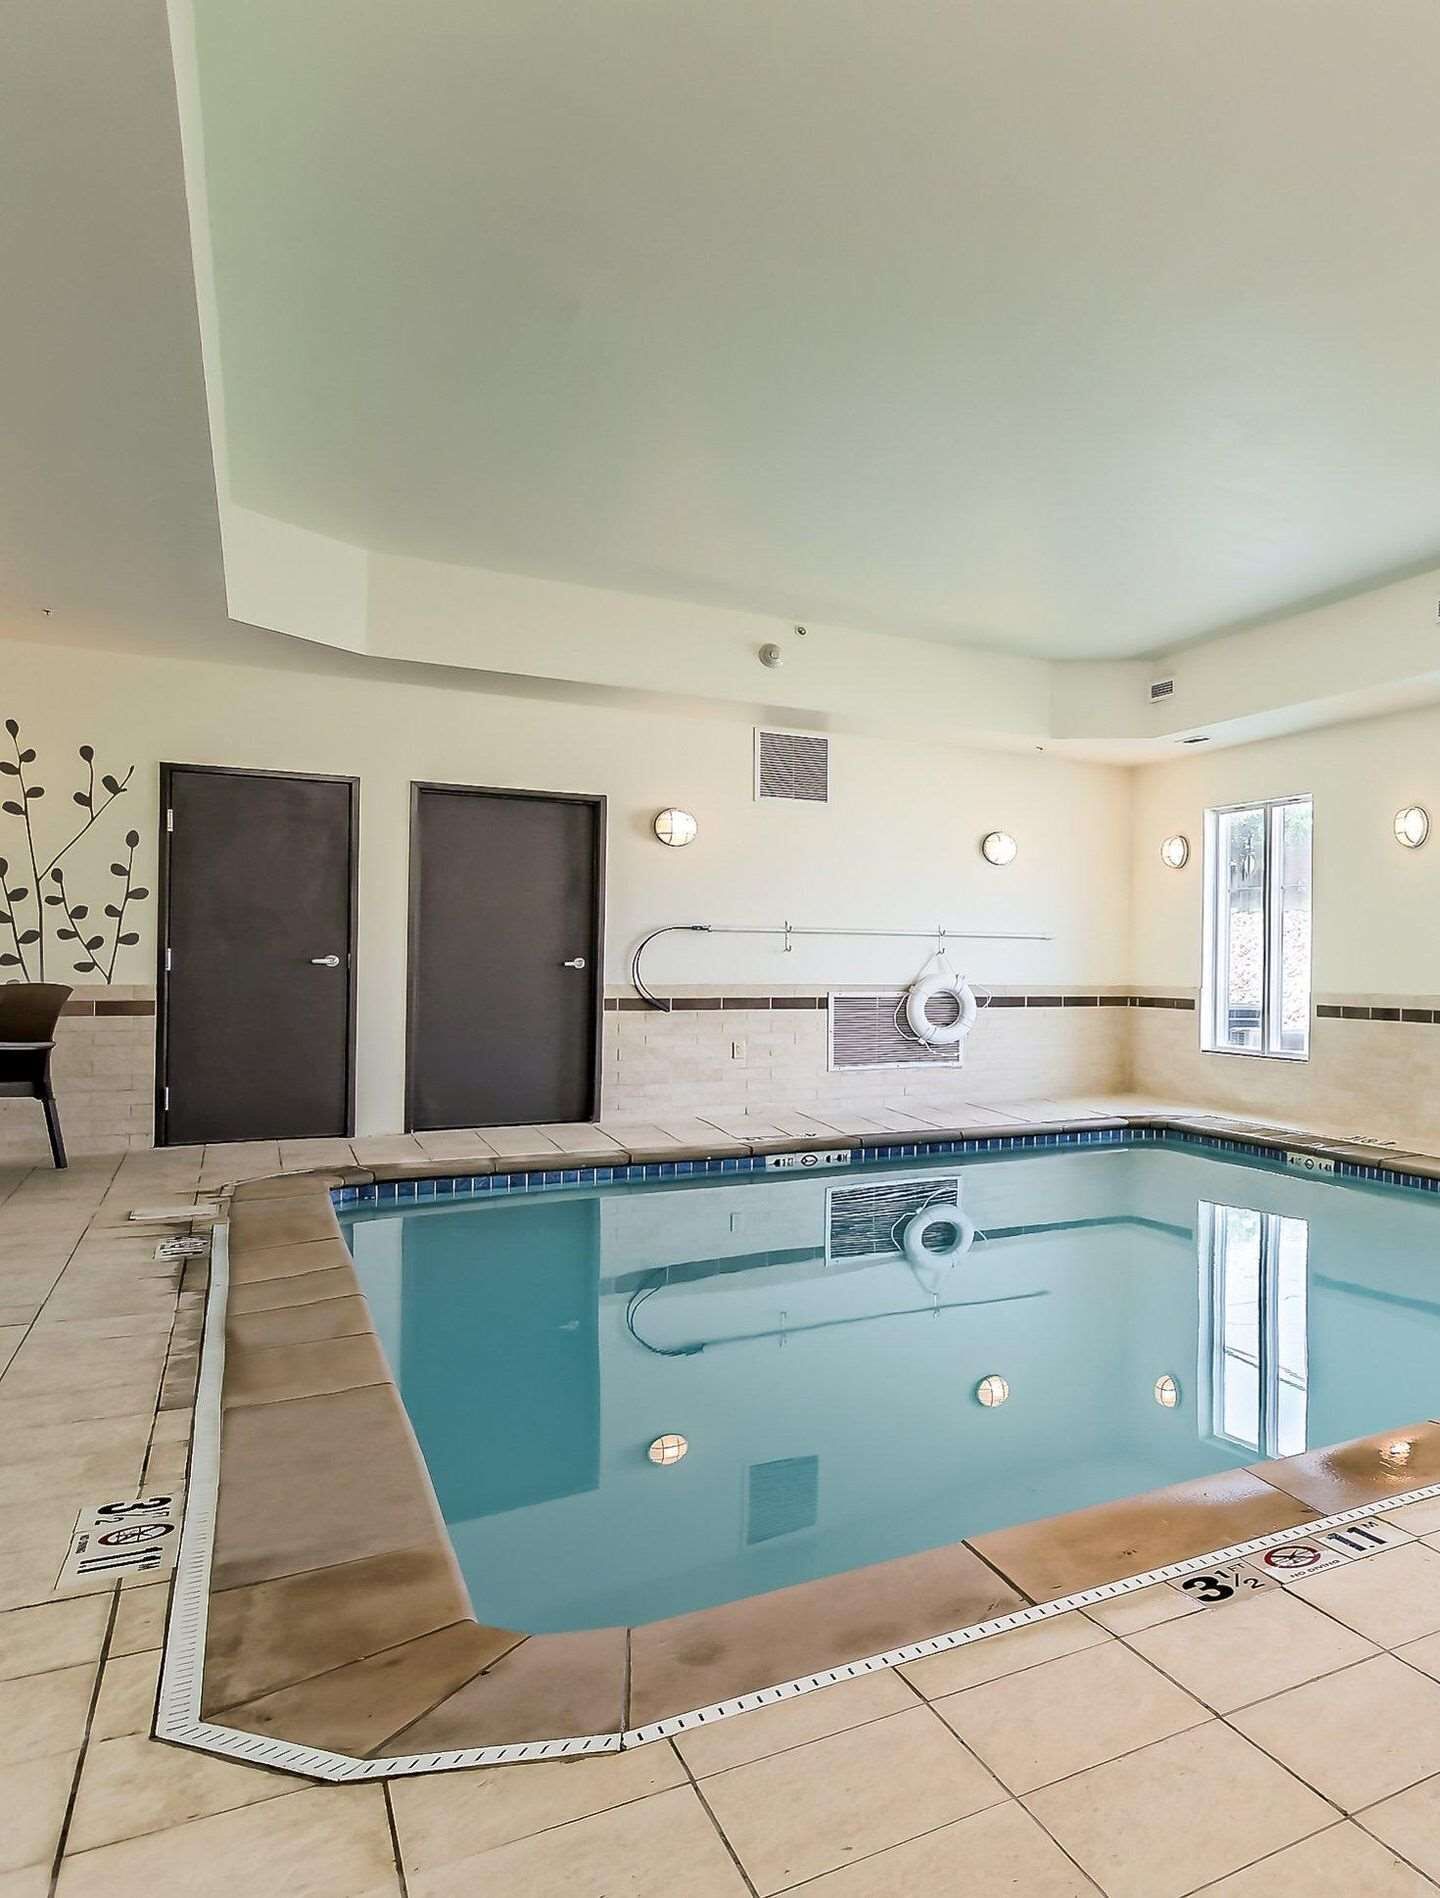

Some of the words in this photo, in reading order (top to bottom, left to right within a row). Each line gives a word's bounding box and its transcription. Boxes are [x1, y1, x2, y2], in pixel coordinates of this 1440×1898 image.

[1363, 1521, 1379, 1530] M
[1290, 1570, 1306, 1579] NO
[1307, 1558, 1341, 1573] DIVING
[1182, 1576, 1235, 1601] 3
